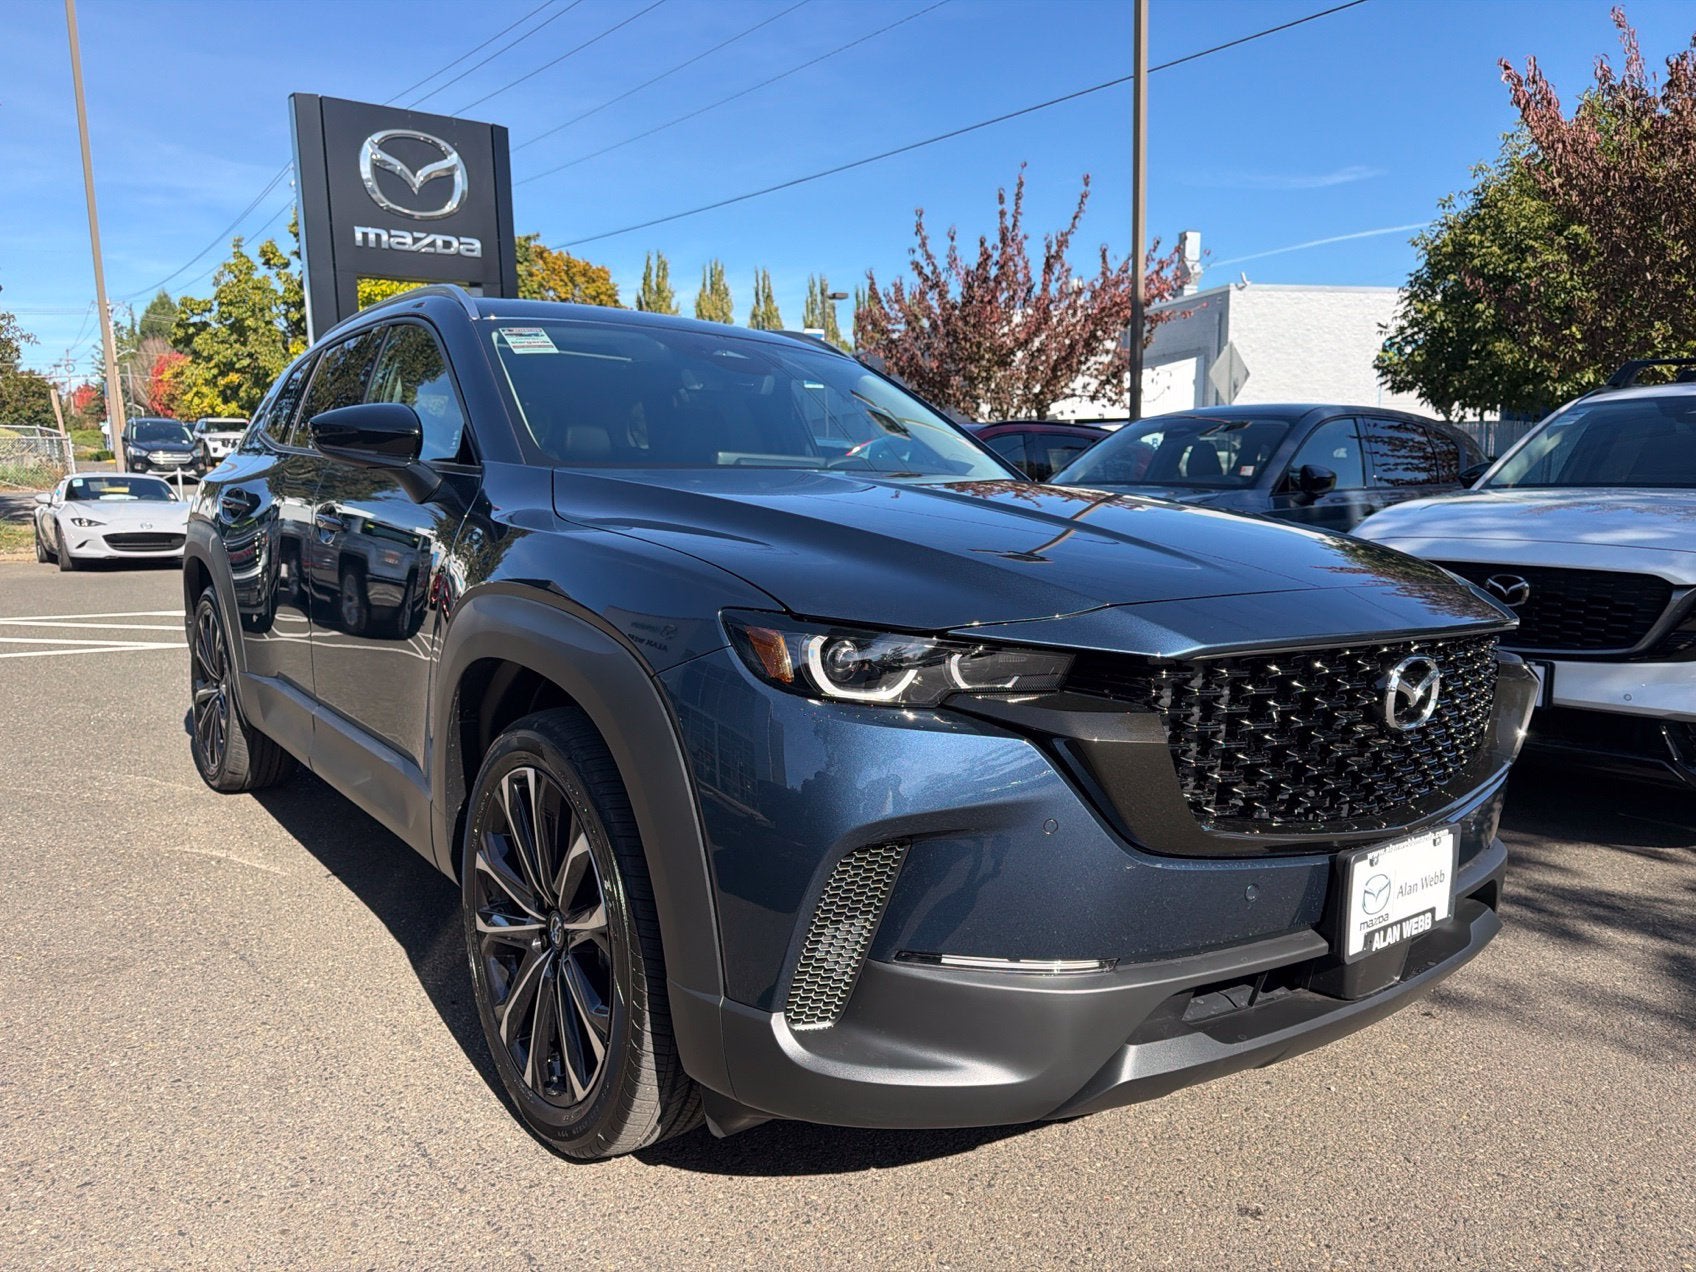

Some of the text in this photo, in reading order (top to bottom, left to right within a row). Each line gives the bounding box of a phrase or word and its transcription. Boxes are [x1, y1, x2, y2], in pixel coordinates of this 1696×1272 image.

[353, 225, 482, 258] mazda
[1397, 870, 1445, 899] Alan Webb
[1372, 912, 1432, 951] ALAN WEBB
